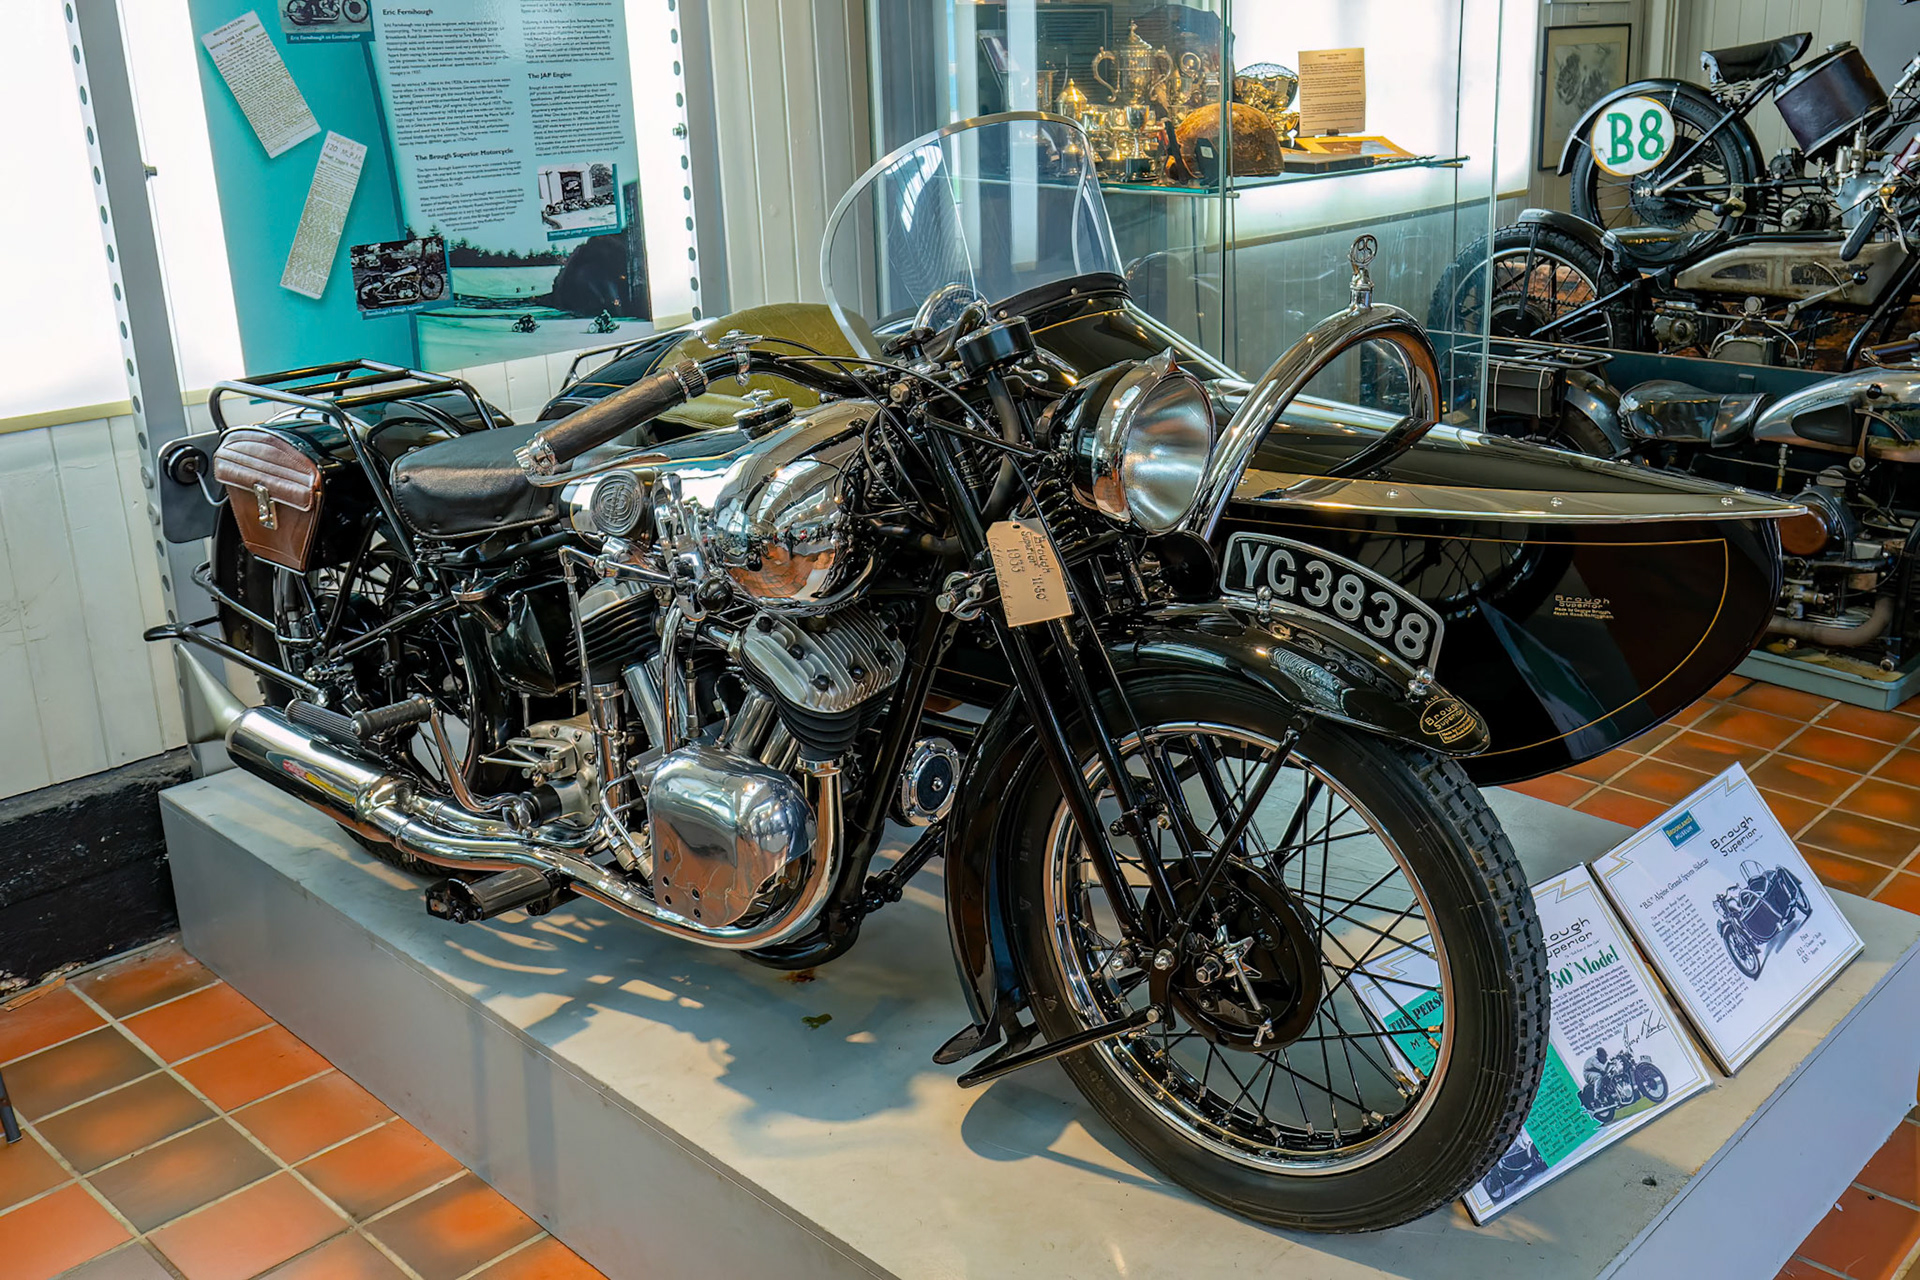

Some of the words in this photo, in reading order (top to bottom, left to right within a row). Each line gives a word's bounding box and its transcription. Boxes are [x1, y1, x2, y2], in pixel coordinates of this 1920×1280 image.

[540, 72, 551, 80] JAP
[1607, 109, 1664, 165] B8
[429, 152, 452, 161] Brough
[452, 150, 479, 159] Superior
[480, 148, 514, 156] Motorcycle
[1007, 548, 1025, 573] 1933
[1019, 530, 1038, 567] Superior
[1033, 534, 1054, 574] Brough
[1555, 594, 1610, 605] Brough
[1559, 601, 1603, 609] Superior
[1675, 825, 1694, 841] MUSEUM
[1710, 815, 1754, 850] Brough
[1720, 827, 1757, 857] Superior
[1654, 887, 1670, 902] Alpine
[1667, 875, 1683, 891] Grand
[1681, 869, 1695, 882] Sports
[1692, 858, 1709, 871] Sidecar
[1546, 932, 1592, 958] uperior
[1574, 943, 1620, 980] Model
